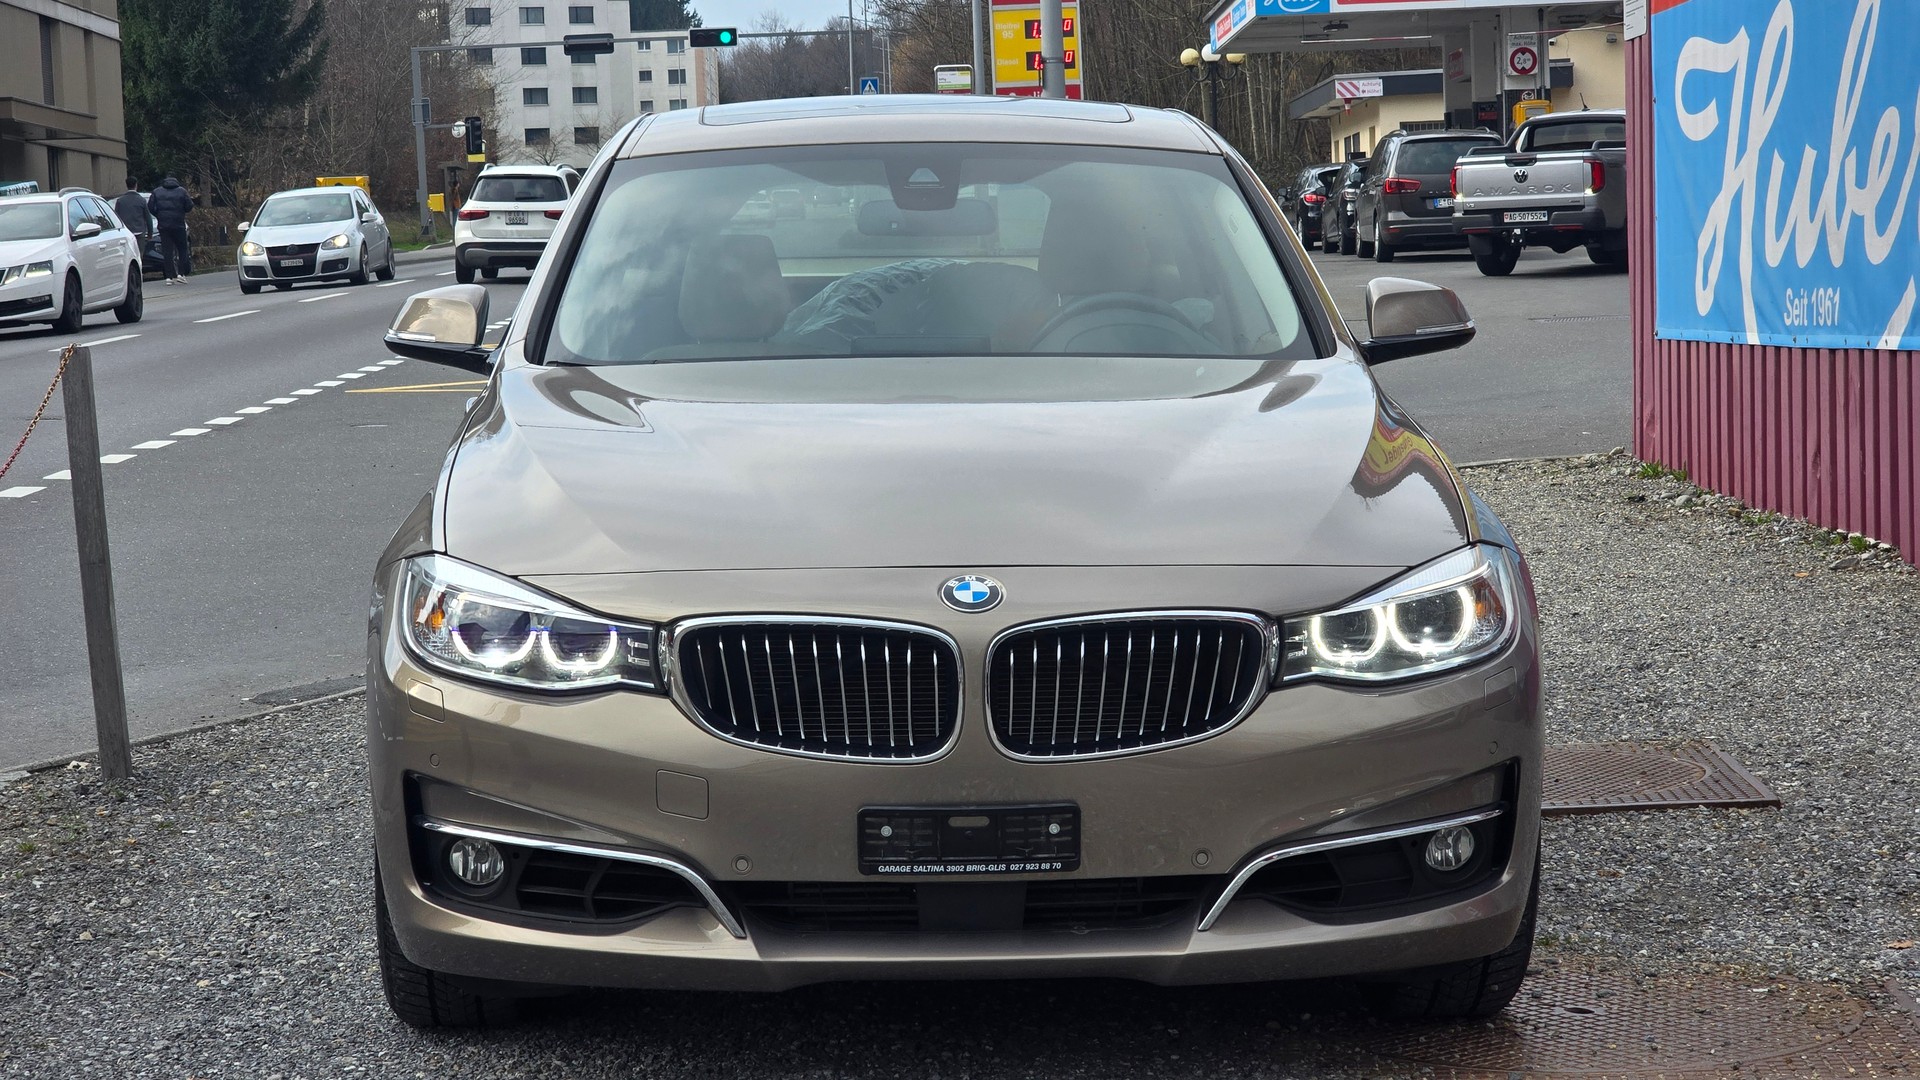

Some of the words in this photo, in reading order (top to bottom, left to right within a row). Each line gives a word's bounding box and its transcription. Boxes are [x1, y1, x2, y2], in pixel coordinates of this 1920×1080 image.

[1002, 30, 1014, 39] 95
[1473, 183, 1572, 197] AMAROK
[1783, 287, 1808, 327] Seit
[1811, 286, 1841, 327] 1961
[947, 575, 996, 588] BMW
[878, 865, 912, 873] GARAGE
[912, 865, 945, 873] SALTINA
[965, 864, 1006, 872] BRIG-GLIS
[1009, 863, 1024, 871] 027
